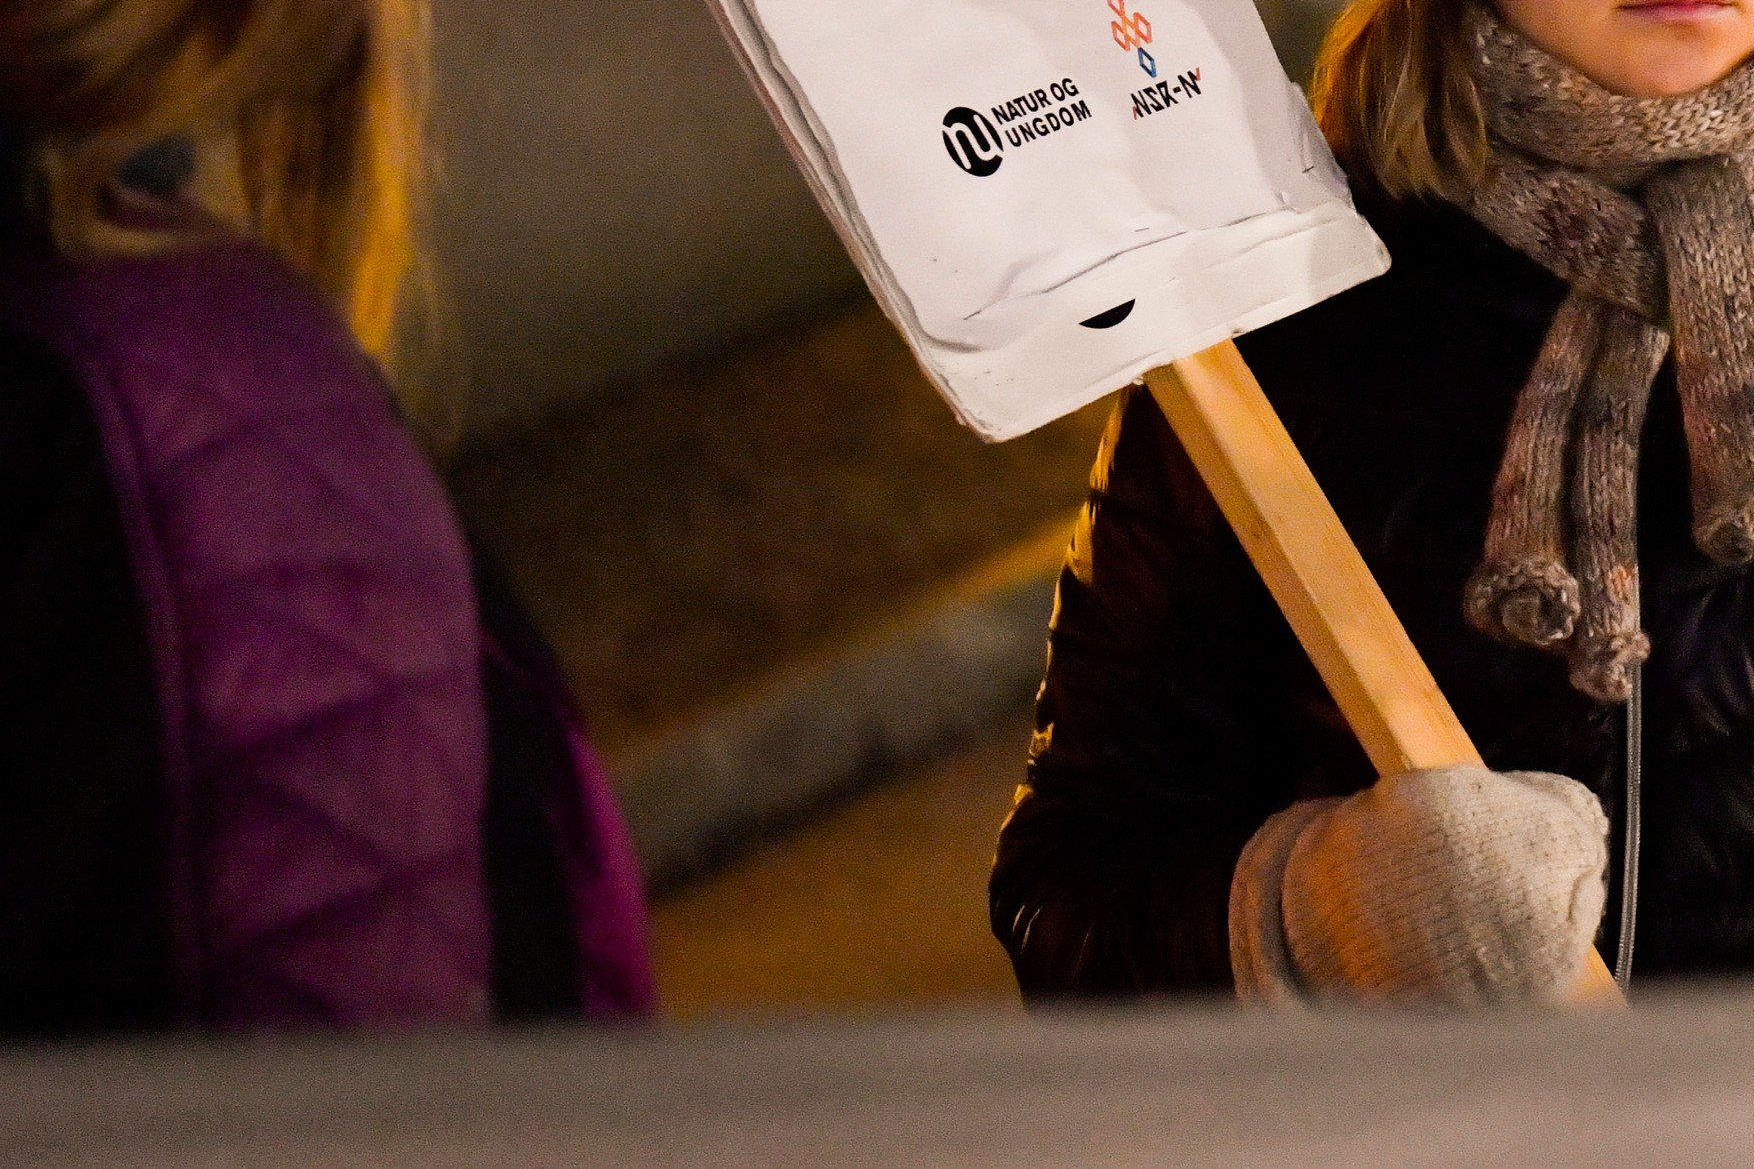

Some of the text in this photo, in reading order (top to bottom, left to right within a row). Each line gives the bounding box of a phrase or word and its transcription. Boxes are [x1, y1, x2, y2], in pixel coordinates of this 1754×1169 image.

[990, 77, 1080, 126] NATUR OG
[1004, 99, 1092, 148] UNGDOM
